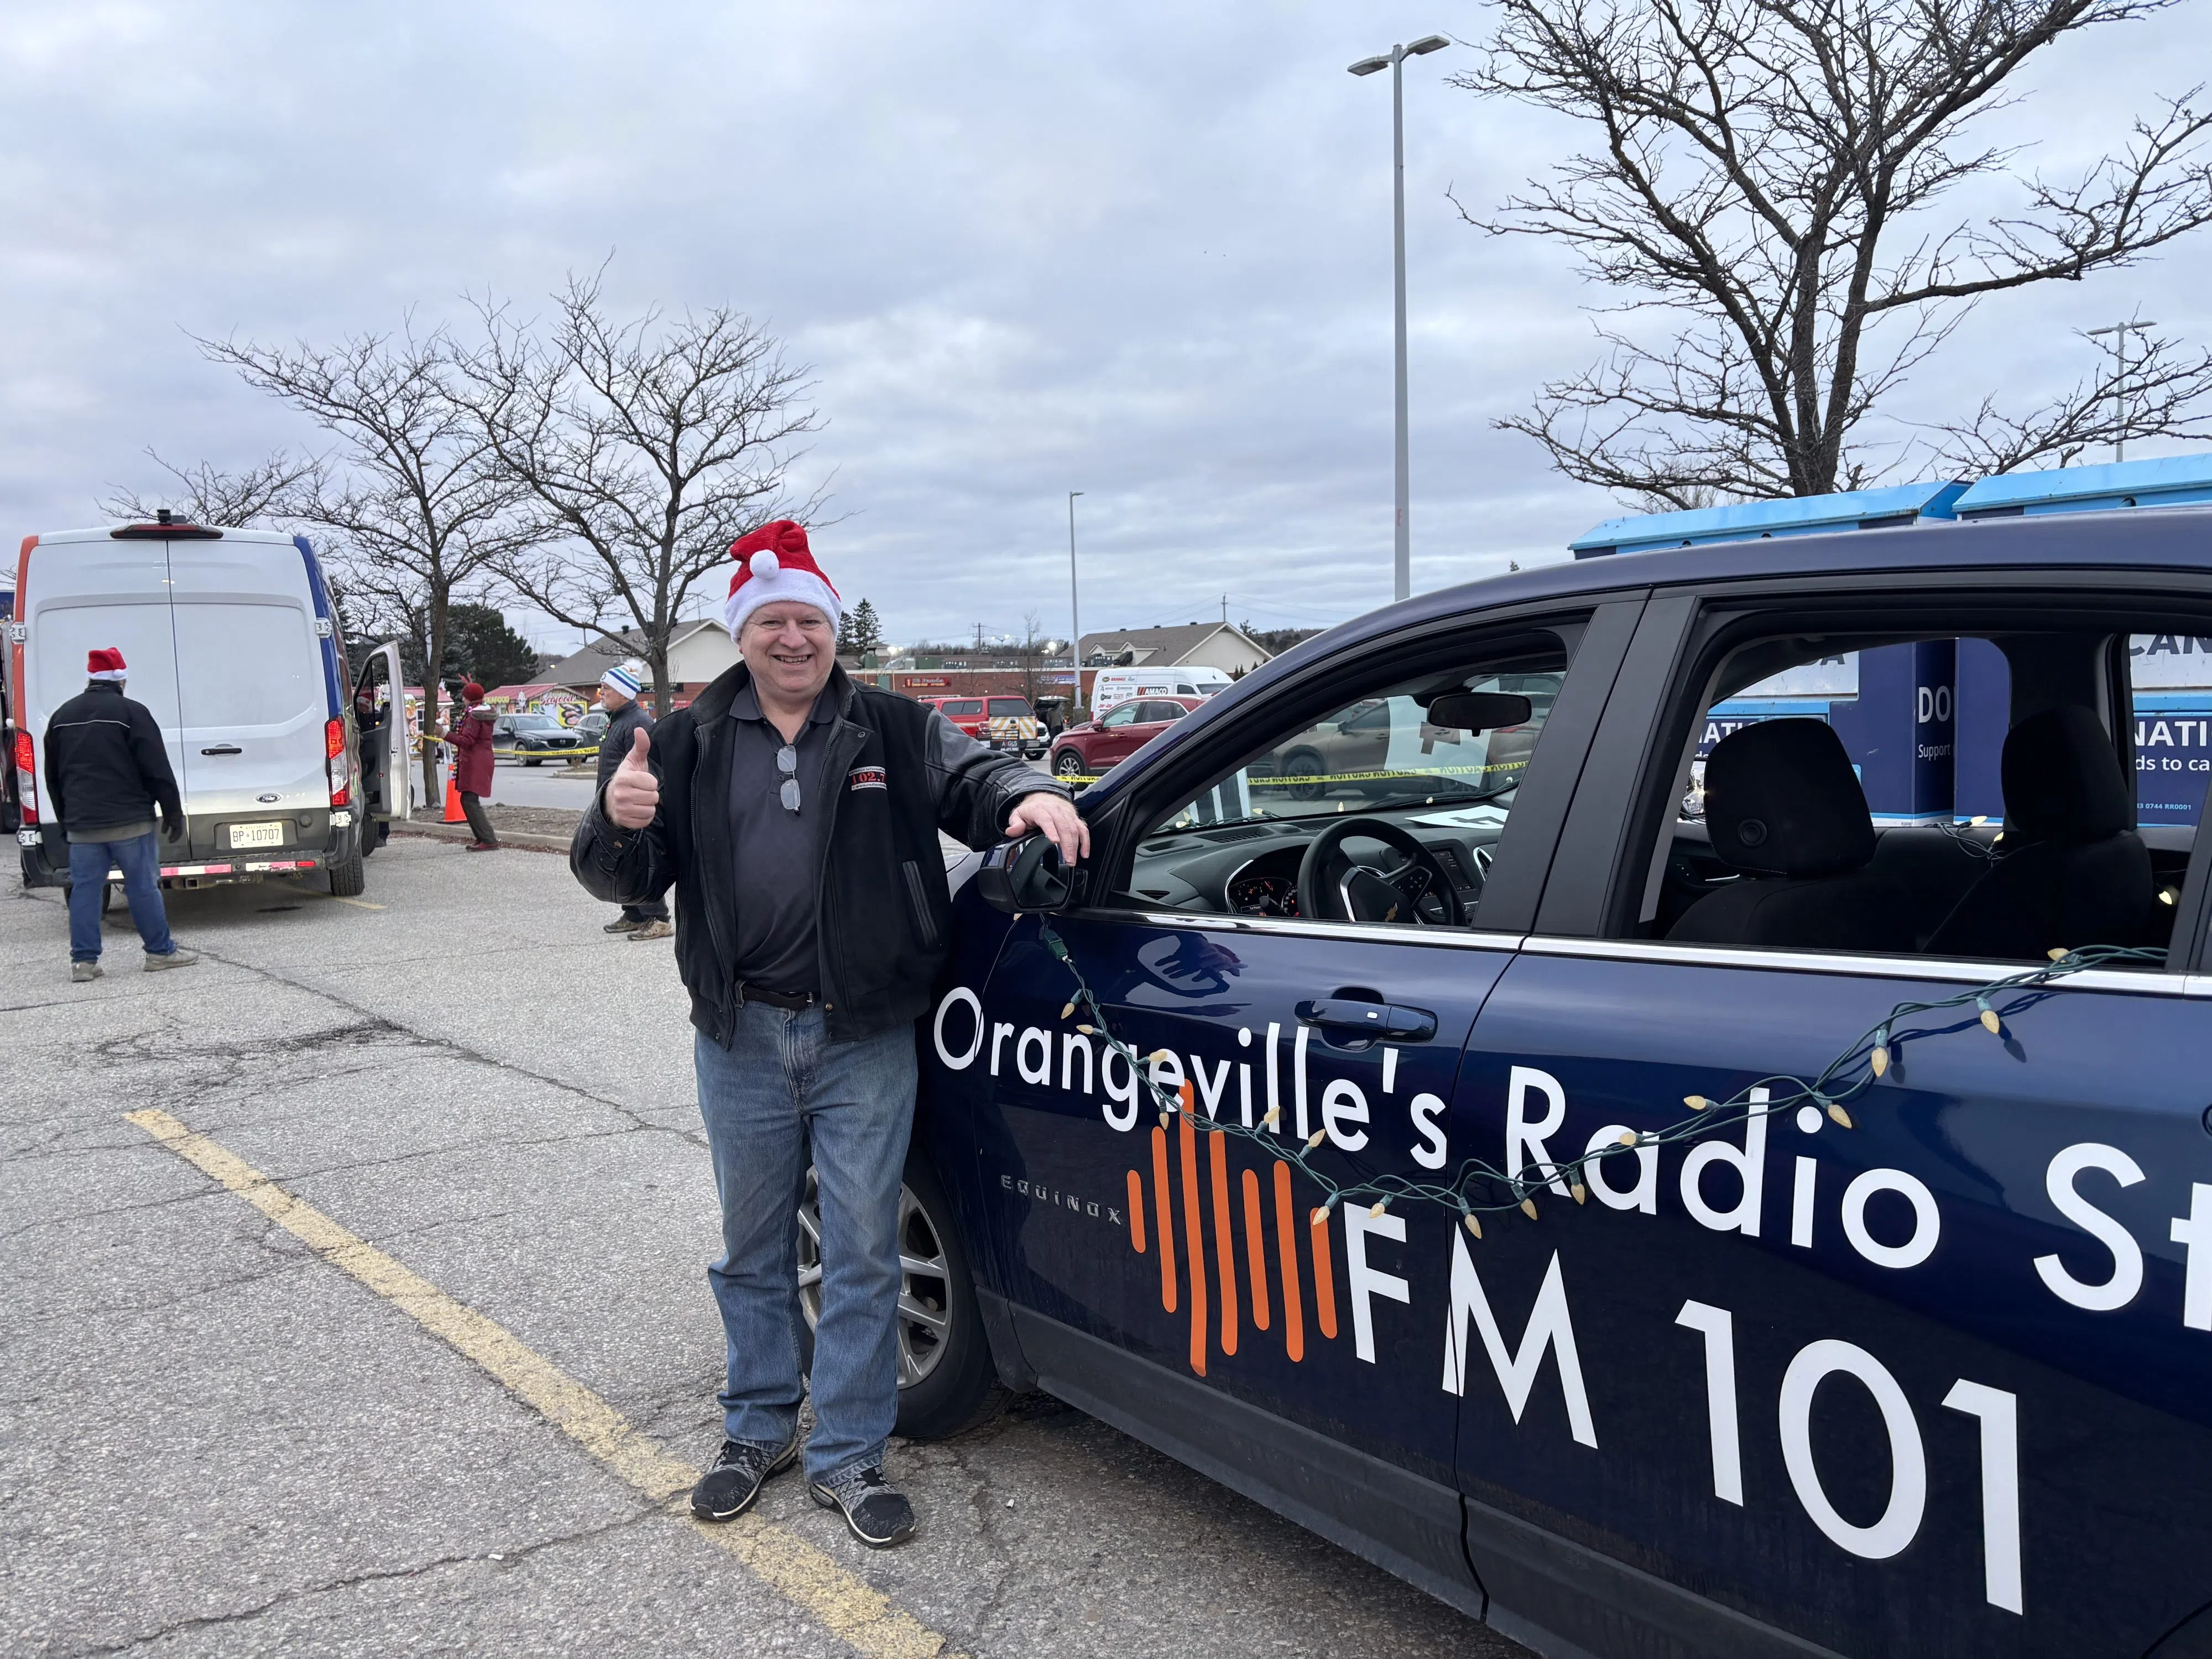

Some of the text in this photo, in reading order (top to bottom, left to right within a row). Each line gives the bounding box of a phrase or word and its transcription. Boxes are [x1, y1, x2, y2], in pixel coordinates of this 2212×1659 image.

[2130, 635, 2212, 656] AN
[539, 692, 576, 707] Seafood
[1918, 685, 1951, 723] DO
[2135, 721, 2212, 747] NATI
[1918, 743, 1951, 761] Support
[2162, 757, 2182, 771] to
[2188, 759, 2210, 771] ca
[852, 771, 885, 784] 102.7
[233, 828, 279, 842] BP 10707
[933, 986, 2212, 1332] Orangeville's Radio St
[1000, 1175, 1122, 1226] EQUINOX
[1343, 1201, 2023, 1616] FM 101
